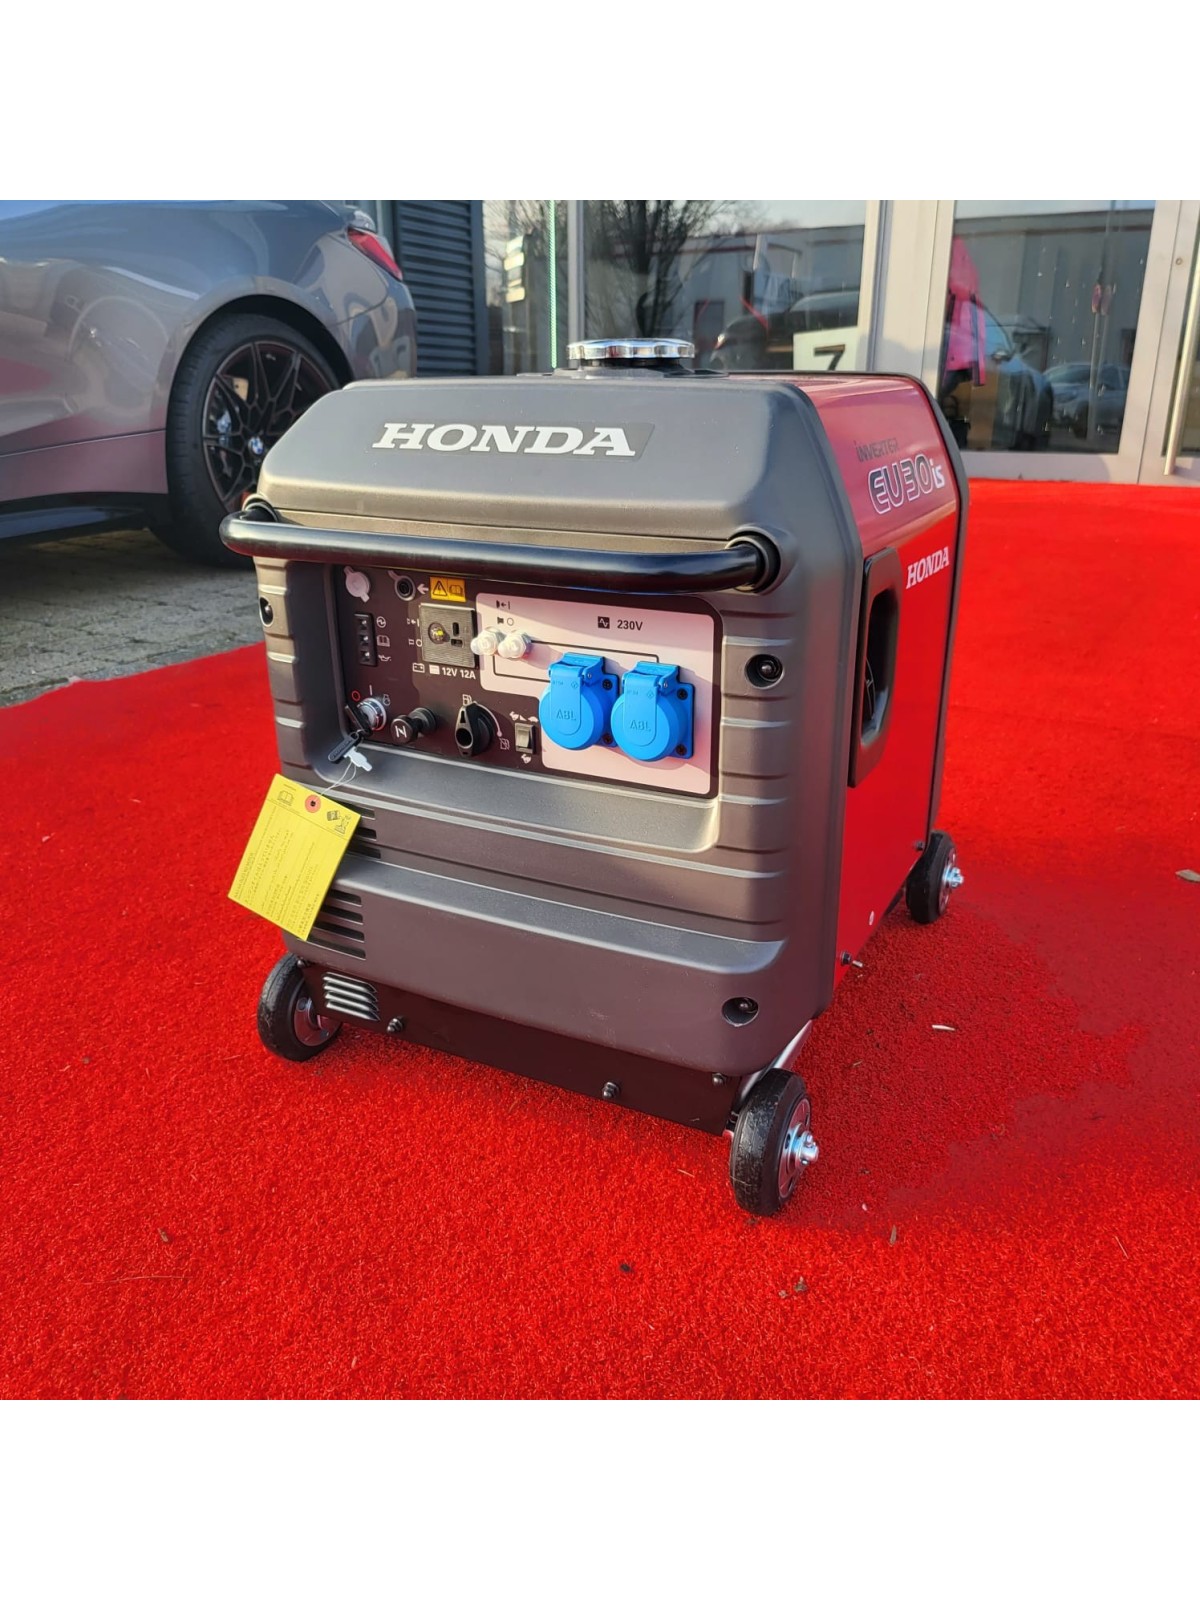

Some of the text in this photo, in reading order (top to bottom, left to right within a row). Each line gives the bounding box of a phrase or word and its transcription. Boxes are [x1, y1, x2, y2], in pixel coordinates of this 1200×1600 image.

[372, 422, 636, 456] HONDA
[905, 546, 950, 590] HONDA
[617, 619, 643, 631] 230V
[441, 666, 476, 680] 12V 12A
[556, 708, 577, 721] ABL
[630, 719, 652, 732] ABL
